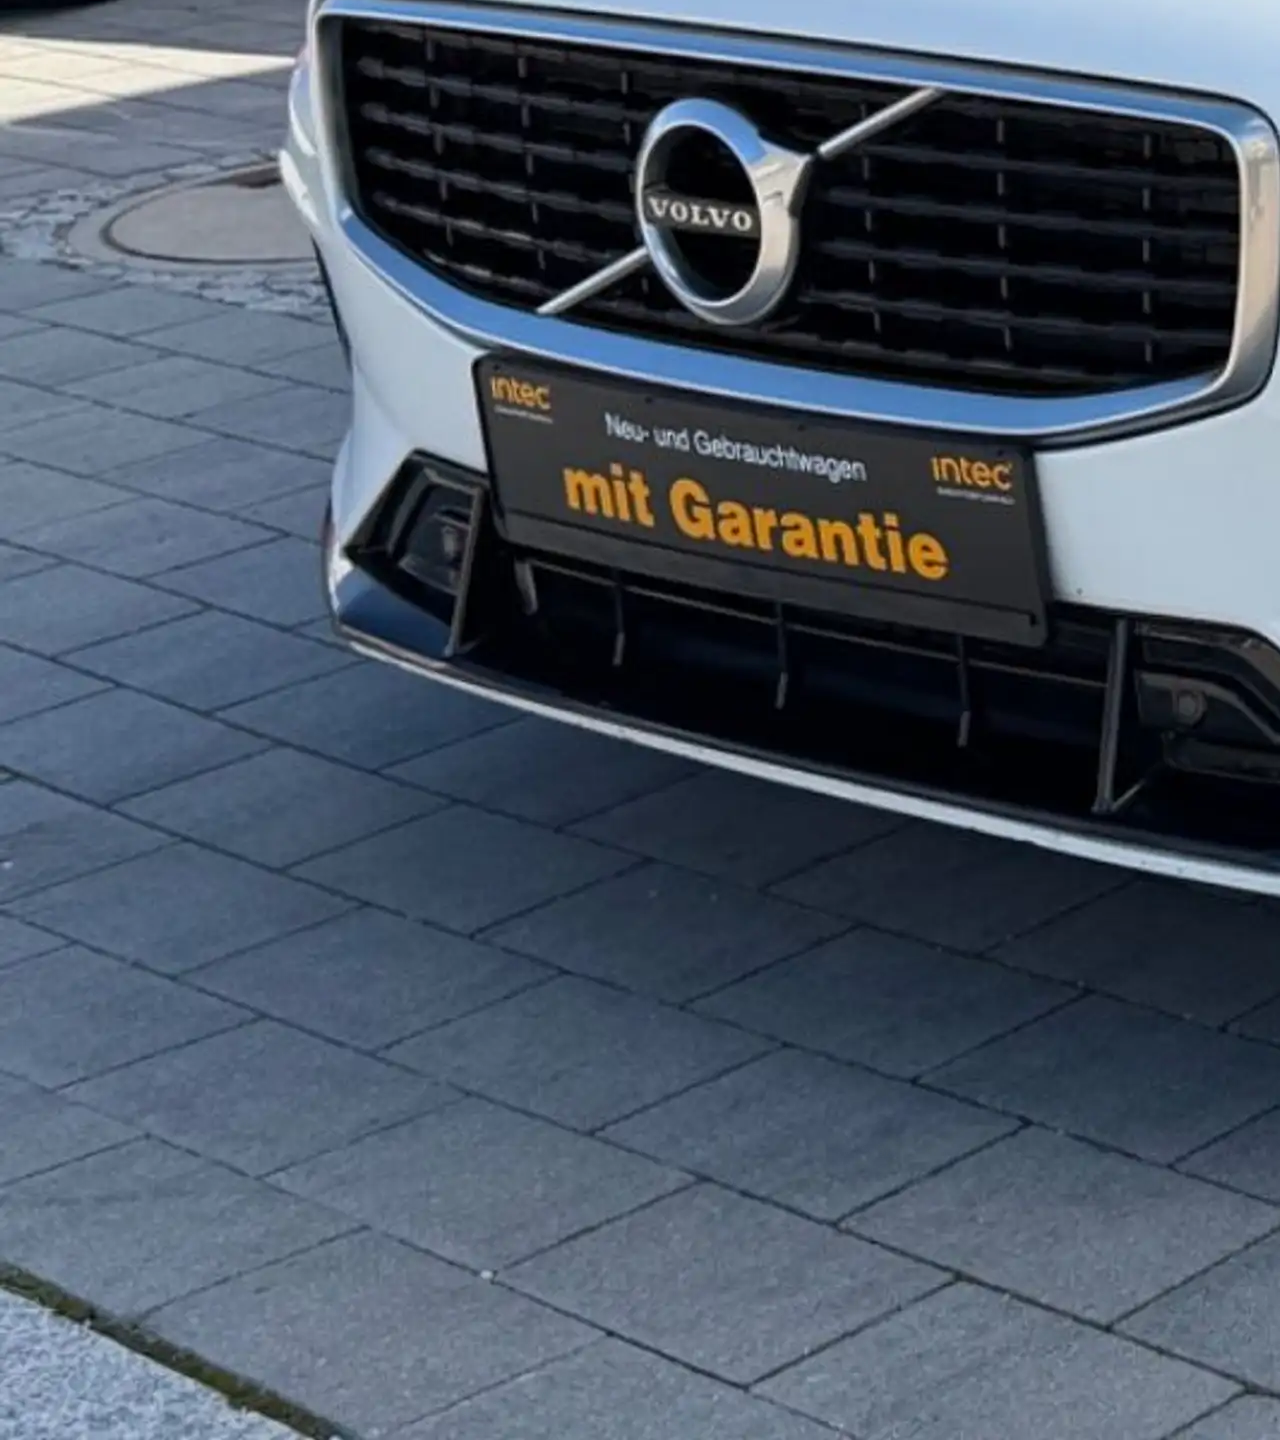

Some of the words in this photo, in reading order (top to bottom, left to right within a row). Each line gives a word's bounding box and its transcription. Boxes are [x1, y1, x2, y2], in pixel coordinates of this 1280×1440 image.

[648, 196, 754, 232] VOLVO
[490, 375, 551, 410] intec
[604, 411, 650, 443] Neu-
[652, 426, 691, 452] und
[693, 429, 868, 484] Gebrauchtwagen
[930, 456, 1013, 491] intec
[562, 461, 655, 527] mit
[669, 477, 950, 580] Garantie
